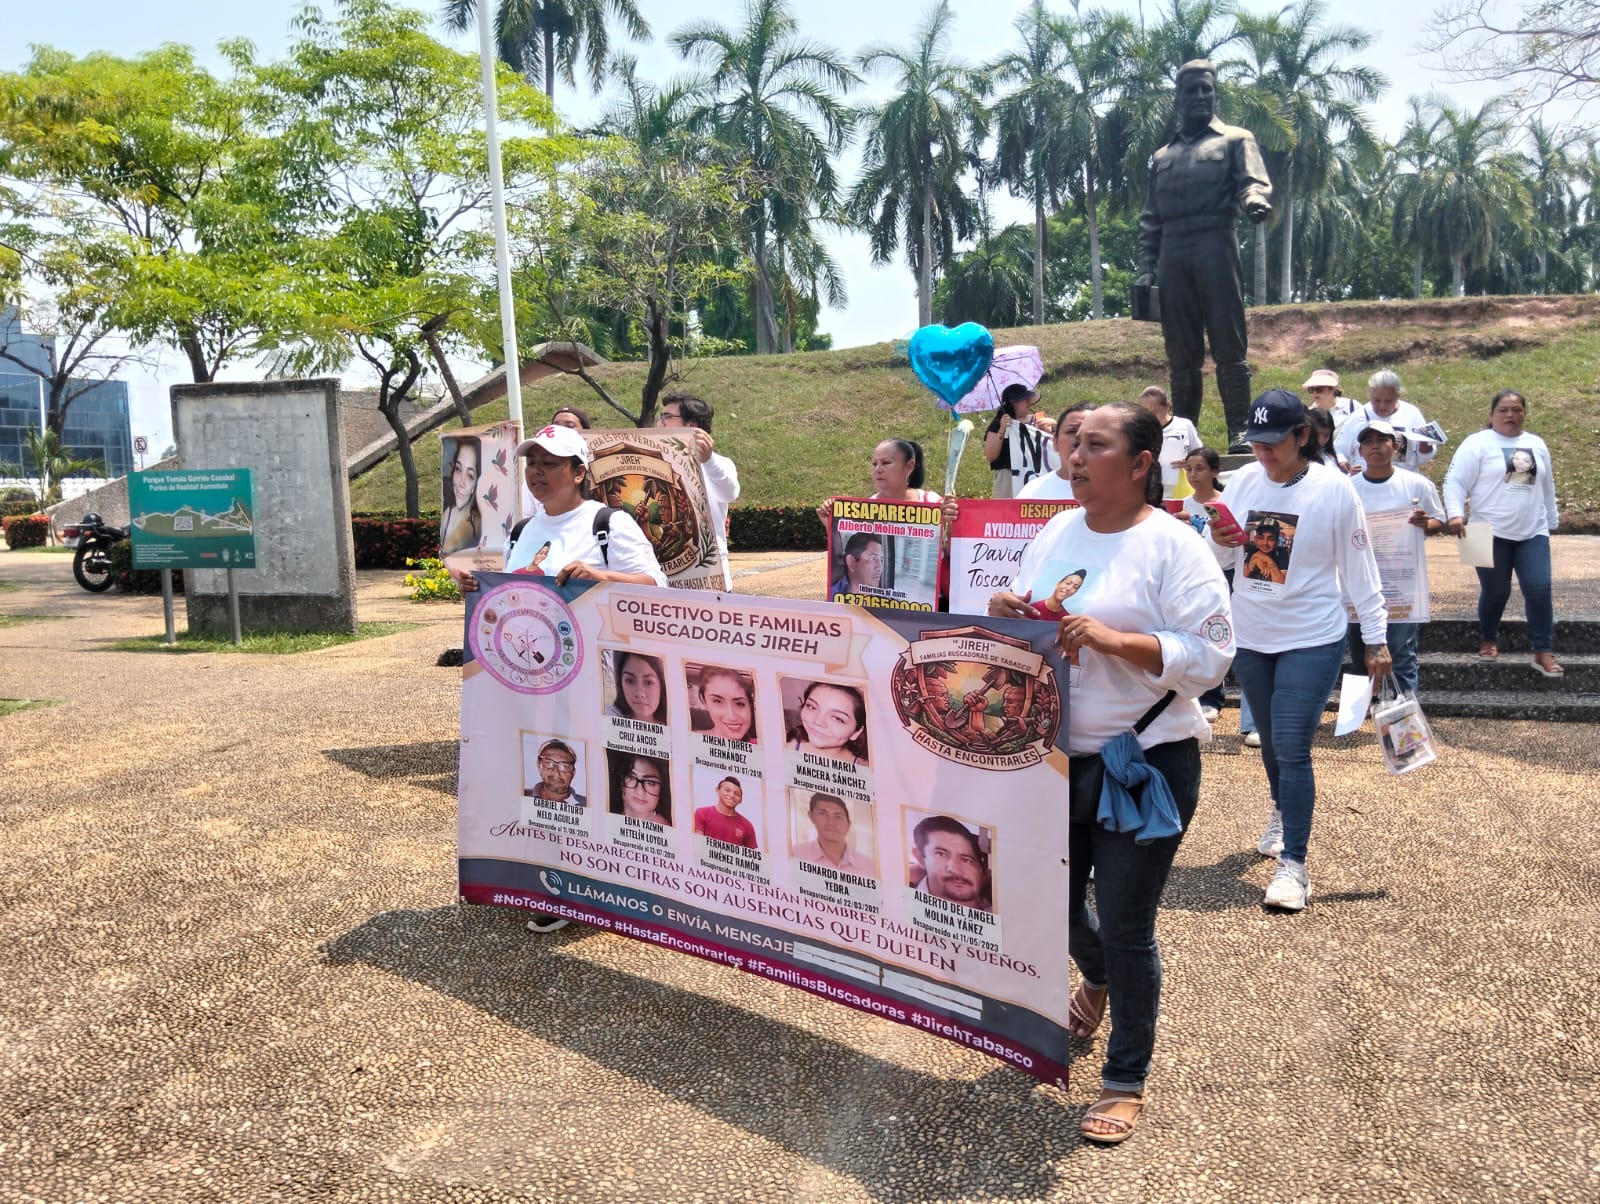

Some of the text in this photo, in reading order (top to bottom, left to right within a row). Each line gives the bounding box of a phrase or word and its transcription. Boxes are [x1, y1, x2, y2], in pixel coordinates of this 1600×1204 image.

[614, 433, 629, 442] POR
[631, 434, 671, 455] VERDAD
[143, 476, 165, 485] Parque
[188, 474, 210, 482] Garrido
[211, 474, 235, 482] Canabal
[833, 500, 942, 525] DESAPARECIDO
[838, 520, 935, 538] Alberto Molina Yanes
[661, 551, 695, 571] TRARLES
[971, 543, 1028, 567] David
[684, 577, 704, 590] HASTA
[859, 584, 885, 595] Informes
[616, 599, 841, 637] COLECTIVO DE FAMILIAS
[633, 619, 818, 654] BUSCADORAS JIREH
[953, 639, 996, 651] "JIREH"
[919, 651, 946, 662] FAMILIAS
[948, 650, 989, 661] BUSCADORAS
[1000, 657, 1032, 671] TABASCO
[619, 731, 657, 746] CRUZ ARCOS
[632, 721, 664, 735] FERNANDA
[702, 734, 753, 753] XIMENA TORRES
[915, 730, 1039, 767] HASTA ENCONTRARLES
[709, 748, 747, 764] HERNÁNDEZ
[803, 753, 830, 768] CITLALI
[796, 765, 866, 790] MANCERA SÁNCHEZ
[794, 777, 829, 792] Desaparecida
[837, 788, 870, 802] 04/11/2020
[533, 798, 584, 815] GABRIEL ARTURO
[554, 813, 580, 826] AGUILAR
[624, 816, 640, 828] EDNA
[620, 827, 669, 848] METELÍN LOYOLA
[706, 837, 740, 854] FERNANDO
[709, 850, 760, 872] JIMÉNEZ RAMÓN
[799, 861, 876, 890] LEONARDO MORALES
[824, 880, 850, 896] YEDRA
[548, 832, 562, 844] DE
[566, 836, 650, 864] DESAPARECER
[652, 855, 685, 873] ERAN
[687, 867, 745, 891] AMADOS,
[750, 882, 800, 905] TENÍAN
[804, 896, 876, 926] NOMBRES
[881, 917, 947, 950] FAMILIAS
[951, 942, 961, 954] Y
[966, 946, 1041, 979] SUEÑOS.
[799, 886, 835, 903] Desaparecido
[844, 899, 879, 914] 22/03/2021
[914, 890, 948, 911] ALBERTO
[950, 902, 965, 917] DEL
[560, 850, 956, 973] NO SON CIFRAS SON AUSENCIAS QUE DUELEN
[568, 882, 794, 956] LLÁMANOS O ENVÍA MENSAJE
[924, 908, 983, 936] MOLINA YÁÑEZ
[913, 916, 999, 952] Desaparecido el 11/05/2023
[493, 893, 1033, 1068] #NoTodosEstamos #HastaEncontrarles #FamiliasBuscadoras #JirehTabasco
